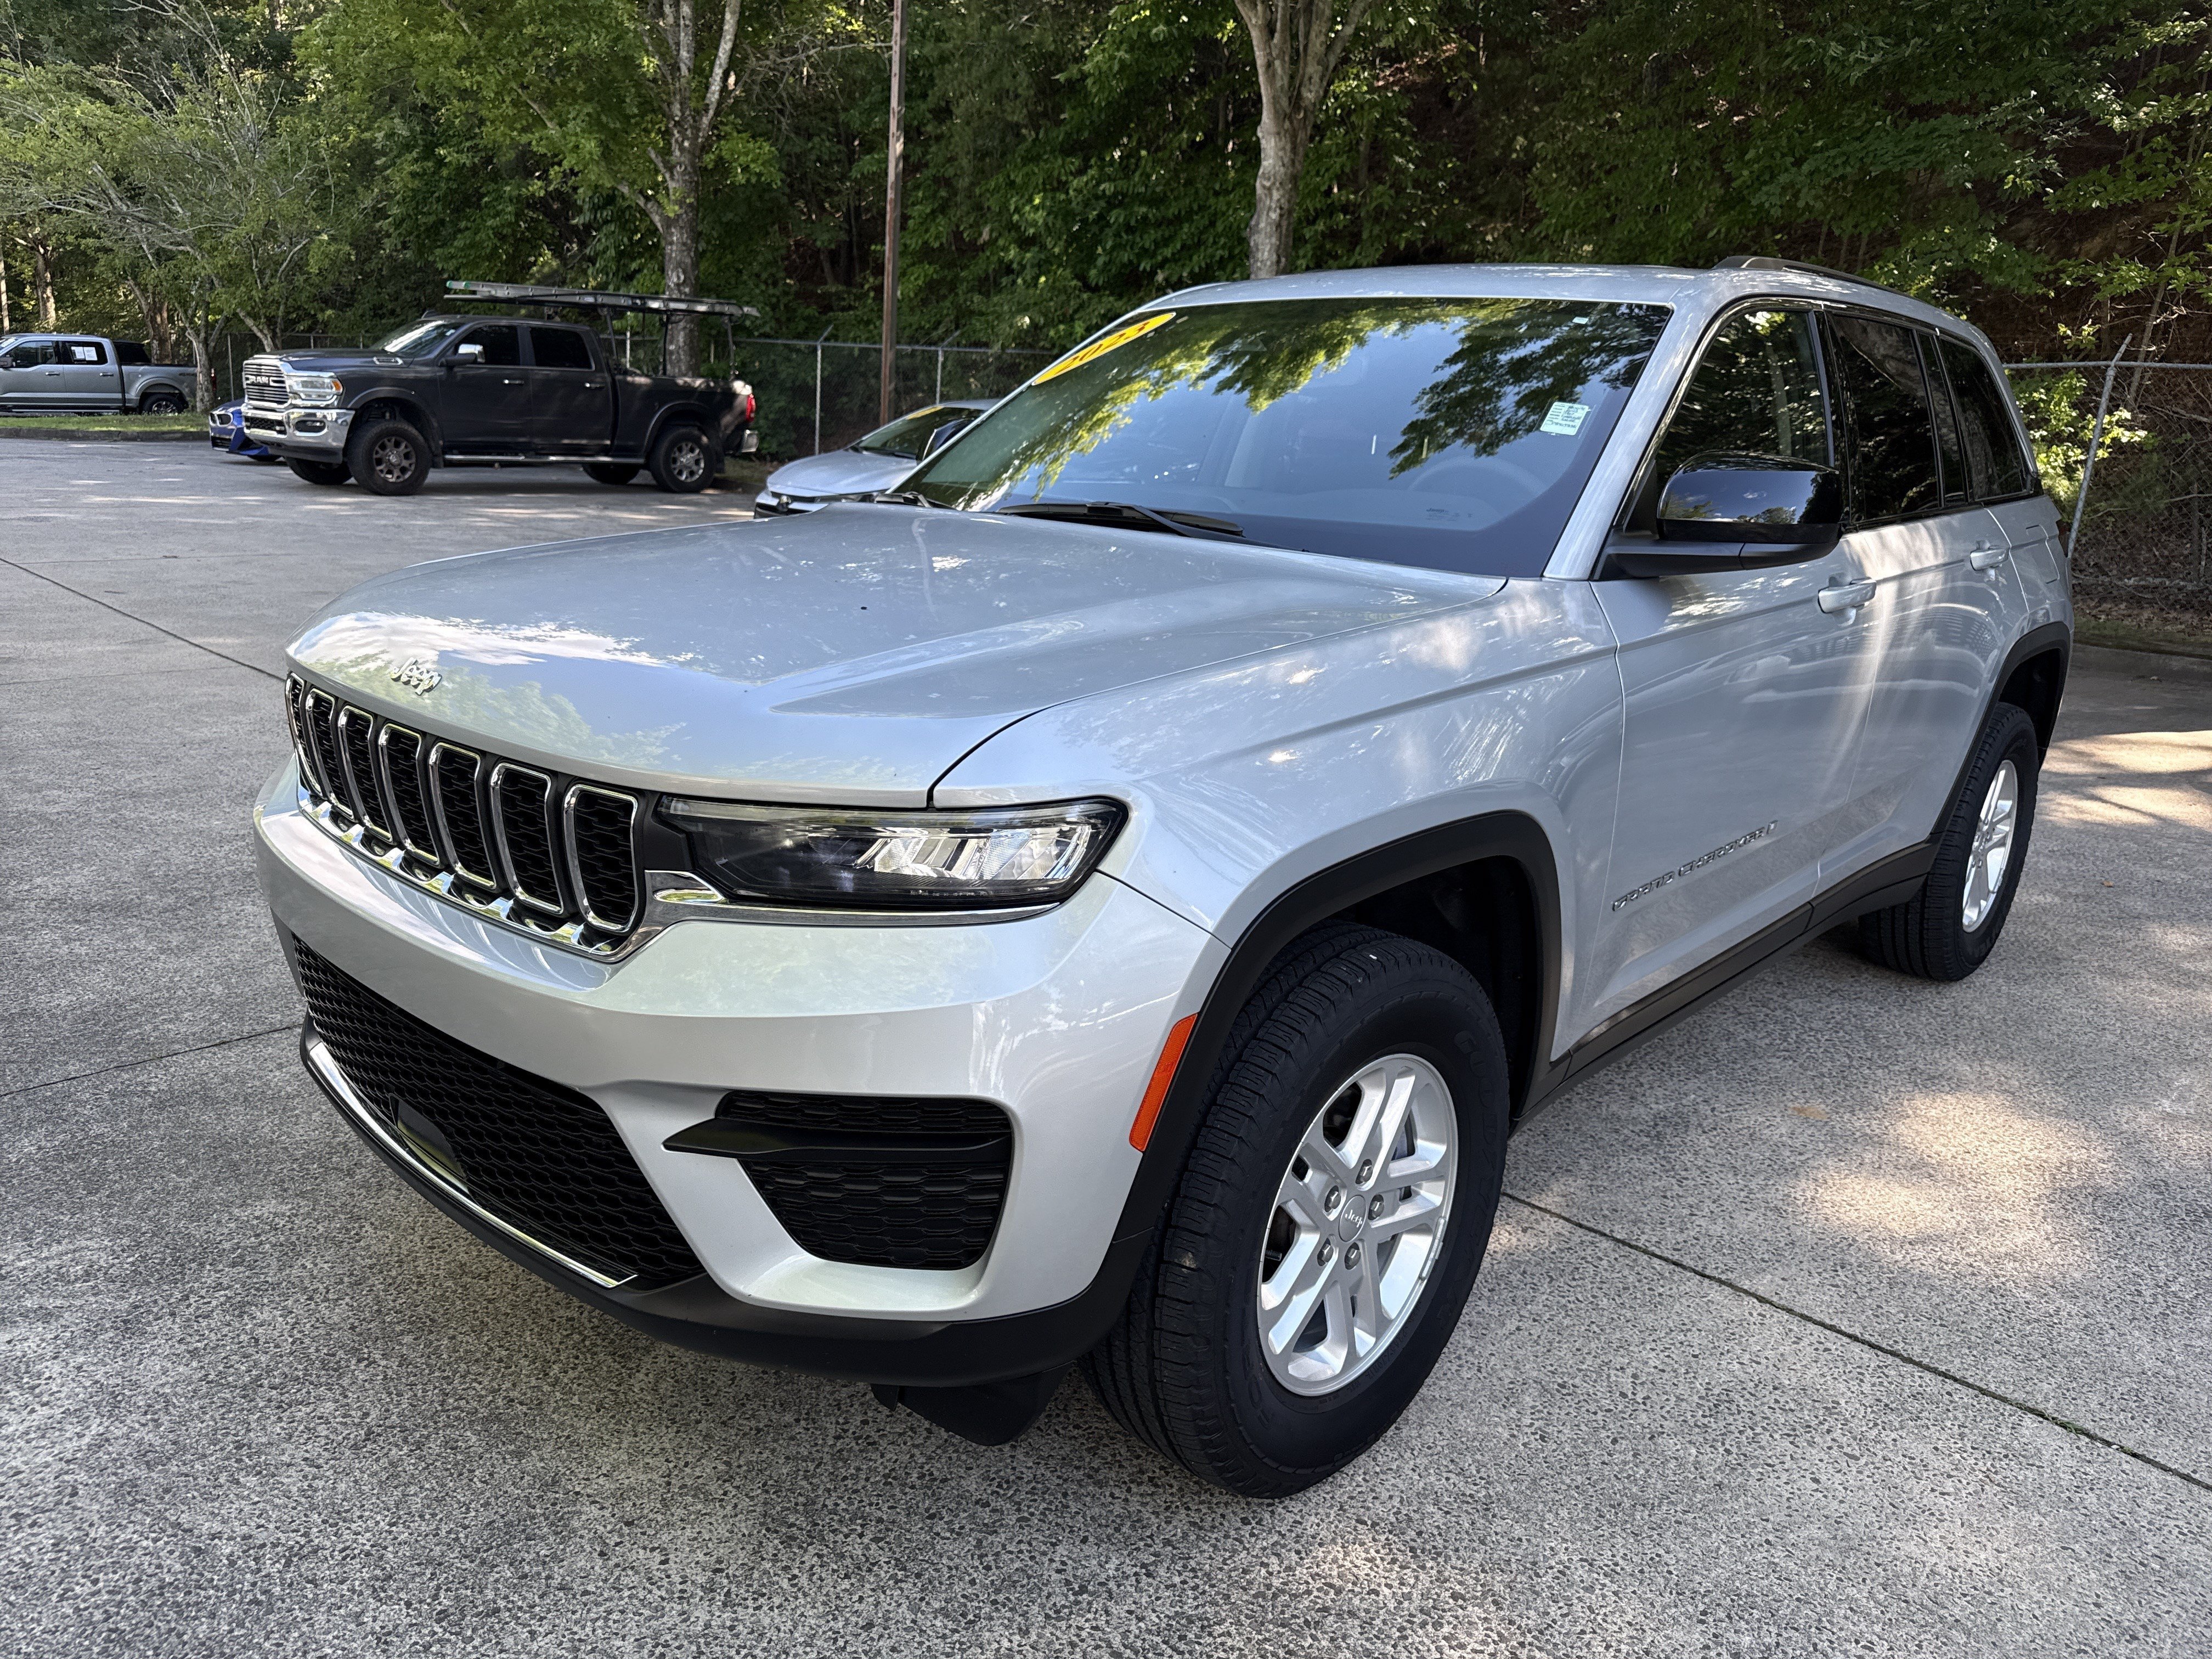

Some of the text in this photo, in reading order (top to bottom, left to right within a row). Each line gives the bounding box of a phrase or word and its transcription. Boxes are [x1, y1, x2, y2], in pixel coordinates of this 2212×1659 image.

[249, 375, 268, 384] RAM
[390, 657, 442, 696] Jeep
[1612, 827, 1765, 911] GRAND CHEROKEE
[1345, 1209, 1363, 1228] Jeep
